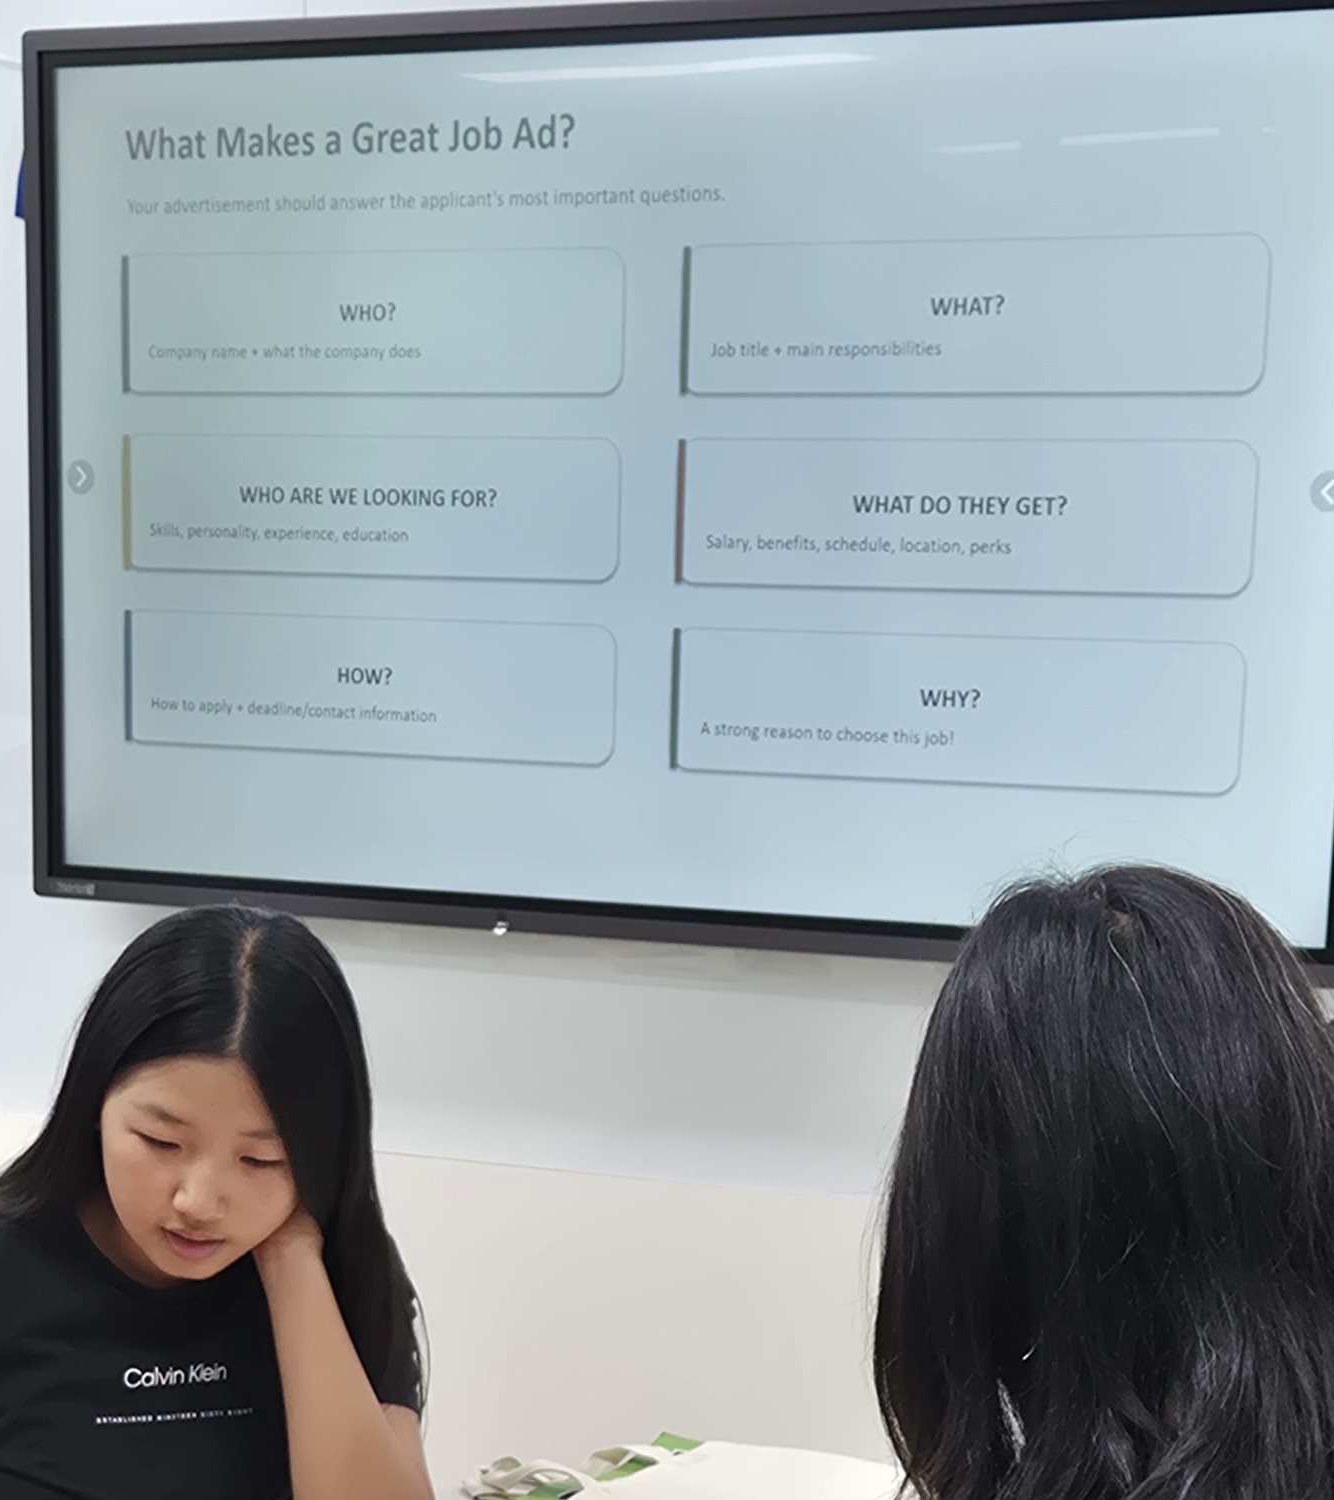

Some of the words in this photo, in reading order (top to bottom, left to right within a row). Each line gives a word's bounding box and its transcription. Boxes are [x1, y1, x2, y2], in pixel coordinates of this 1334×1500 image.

[125, 127, 206, 160] What
[217, 123, 315, 158] Makes
[325, 131, 341, 156] a
[352, 122, 439, 155] Great
[448, 116, 502, 152] Job
[513, 113, 575, 149] Ad?
[126, 199, 159, 215] Your
[163, 197, 270, 214] advertisement
[275, 194, 326, 212] should
[330, 197, 385, 211] answer
[390, 193, 416, 210] the
[420, 190, 504, 212] applicant's
[509, 191, 548, 207] most
[554, 188, 635, 208] important
[640, 185, 725, 207] questions.
[339, 302, 396, 322] WHO?
[931, 294, 1005, 316] WHAT?
[148, 344, 208, 362] Company
[211, 347, 247, 359] name
[263, 345, 295, 359] what
[299, 344, 321, 359] the
[324, 347, 385, 362] company
[389, 343, 421, 359] does
[710, 341, 736, 358] Job
[740, 341, 769, 357] title
[787, 342, 824, 357] main
[828, 340, 942, 360] responsibilities
[240, 486, 285, 504] WHO
[289, 487, 323, 505] ARE
[329, 488, 357, 505] WE
[363, 488, 445, 507] LOOKING
[451, 489, 497, 507] FOR?
[853, 495, 914, 514] WHAT
[920, 495, 951, 515] DO
[958, 496, 1010, 515] THEY
[1016, 495, 1067, 516] GET?
[149, 522, 184, 540] Skills,
[187, 524, 260, 542] personality,
[263, 526, 339, 543] experience,
[342, 526, 408, 542] education
[706, 534, 752, 553] Salary,
[757, 534, 820, 553] benefits,
[825, 536, 895, 555] schedule,
[900, 537, 965, 556] location,
[969, 538, 1012, 557] perks
[338, 667, 393, 685] HOW?
[920, 689, 980, 708] WHY?
[151, 697, 179, 710] How
[182, 700, 196, 712] to
[199, 699, 233, 716] apply
[247, 701, 356, 721] deadline/contact
[359, 705, 437, 723] information
[700, 722, 711, 735] A
[714, 724, 760, 742] strong
[763, 727, 813, 740] reason
[817, 728, 833, 741] to
[836, 726, 889, 743] choose
[893, 728, 920, 745] this
[923, 730, 954, 749] job!
[124, 1366, 185, 1389] Calvin
[188, 1363, 227, 1383] Klein
